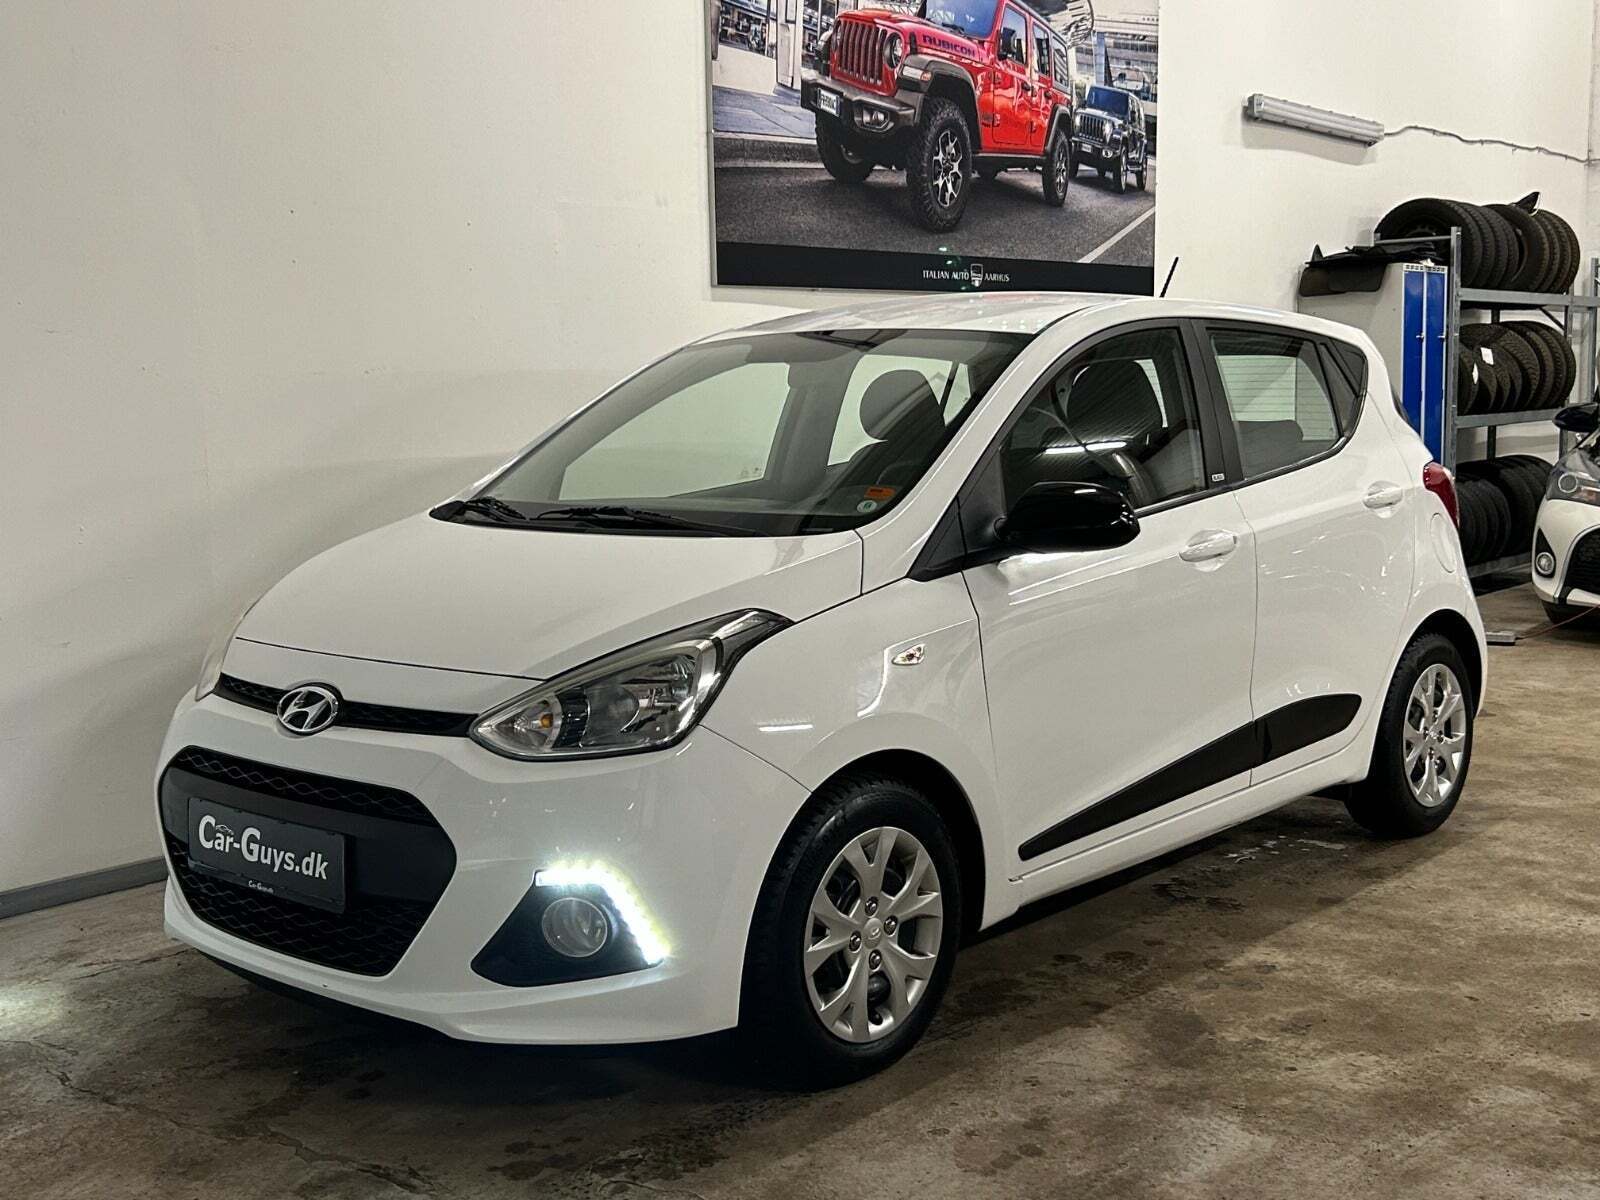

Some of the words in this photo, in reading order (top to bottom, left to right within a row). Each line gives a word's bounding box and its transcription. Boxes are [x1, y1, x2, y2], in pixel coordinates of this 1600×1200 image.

[922, 34, 975, 57] RUBICON
[922, 270, 950, 279] ITALIAN
[951, 271, 969, 280] AUTO
[984, 273, 1010, 282] AARHUS
[198, 815, 329, 880] Car-Guys.dk
